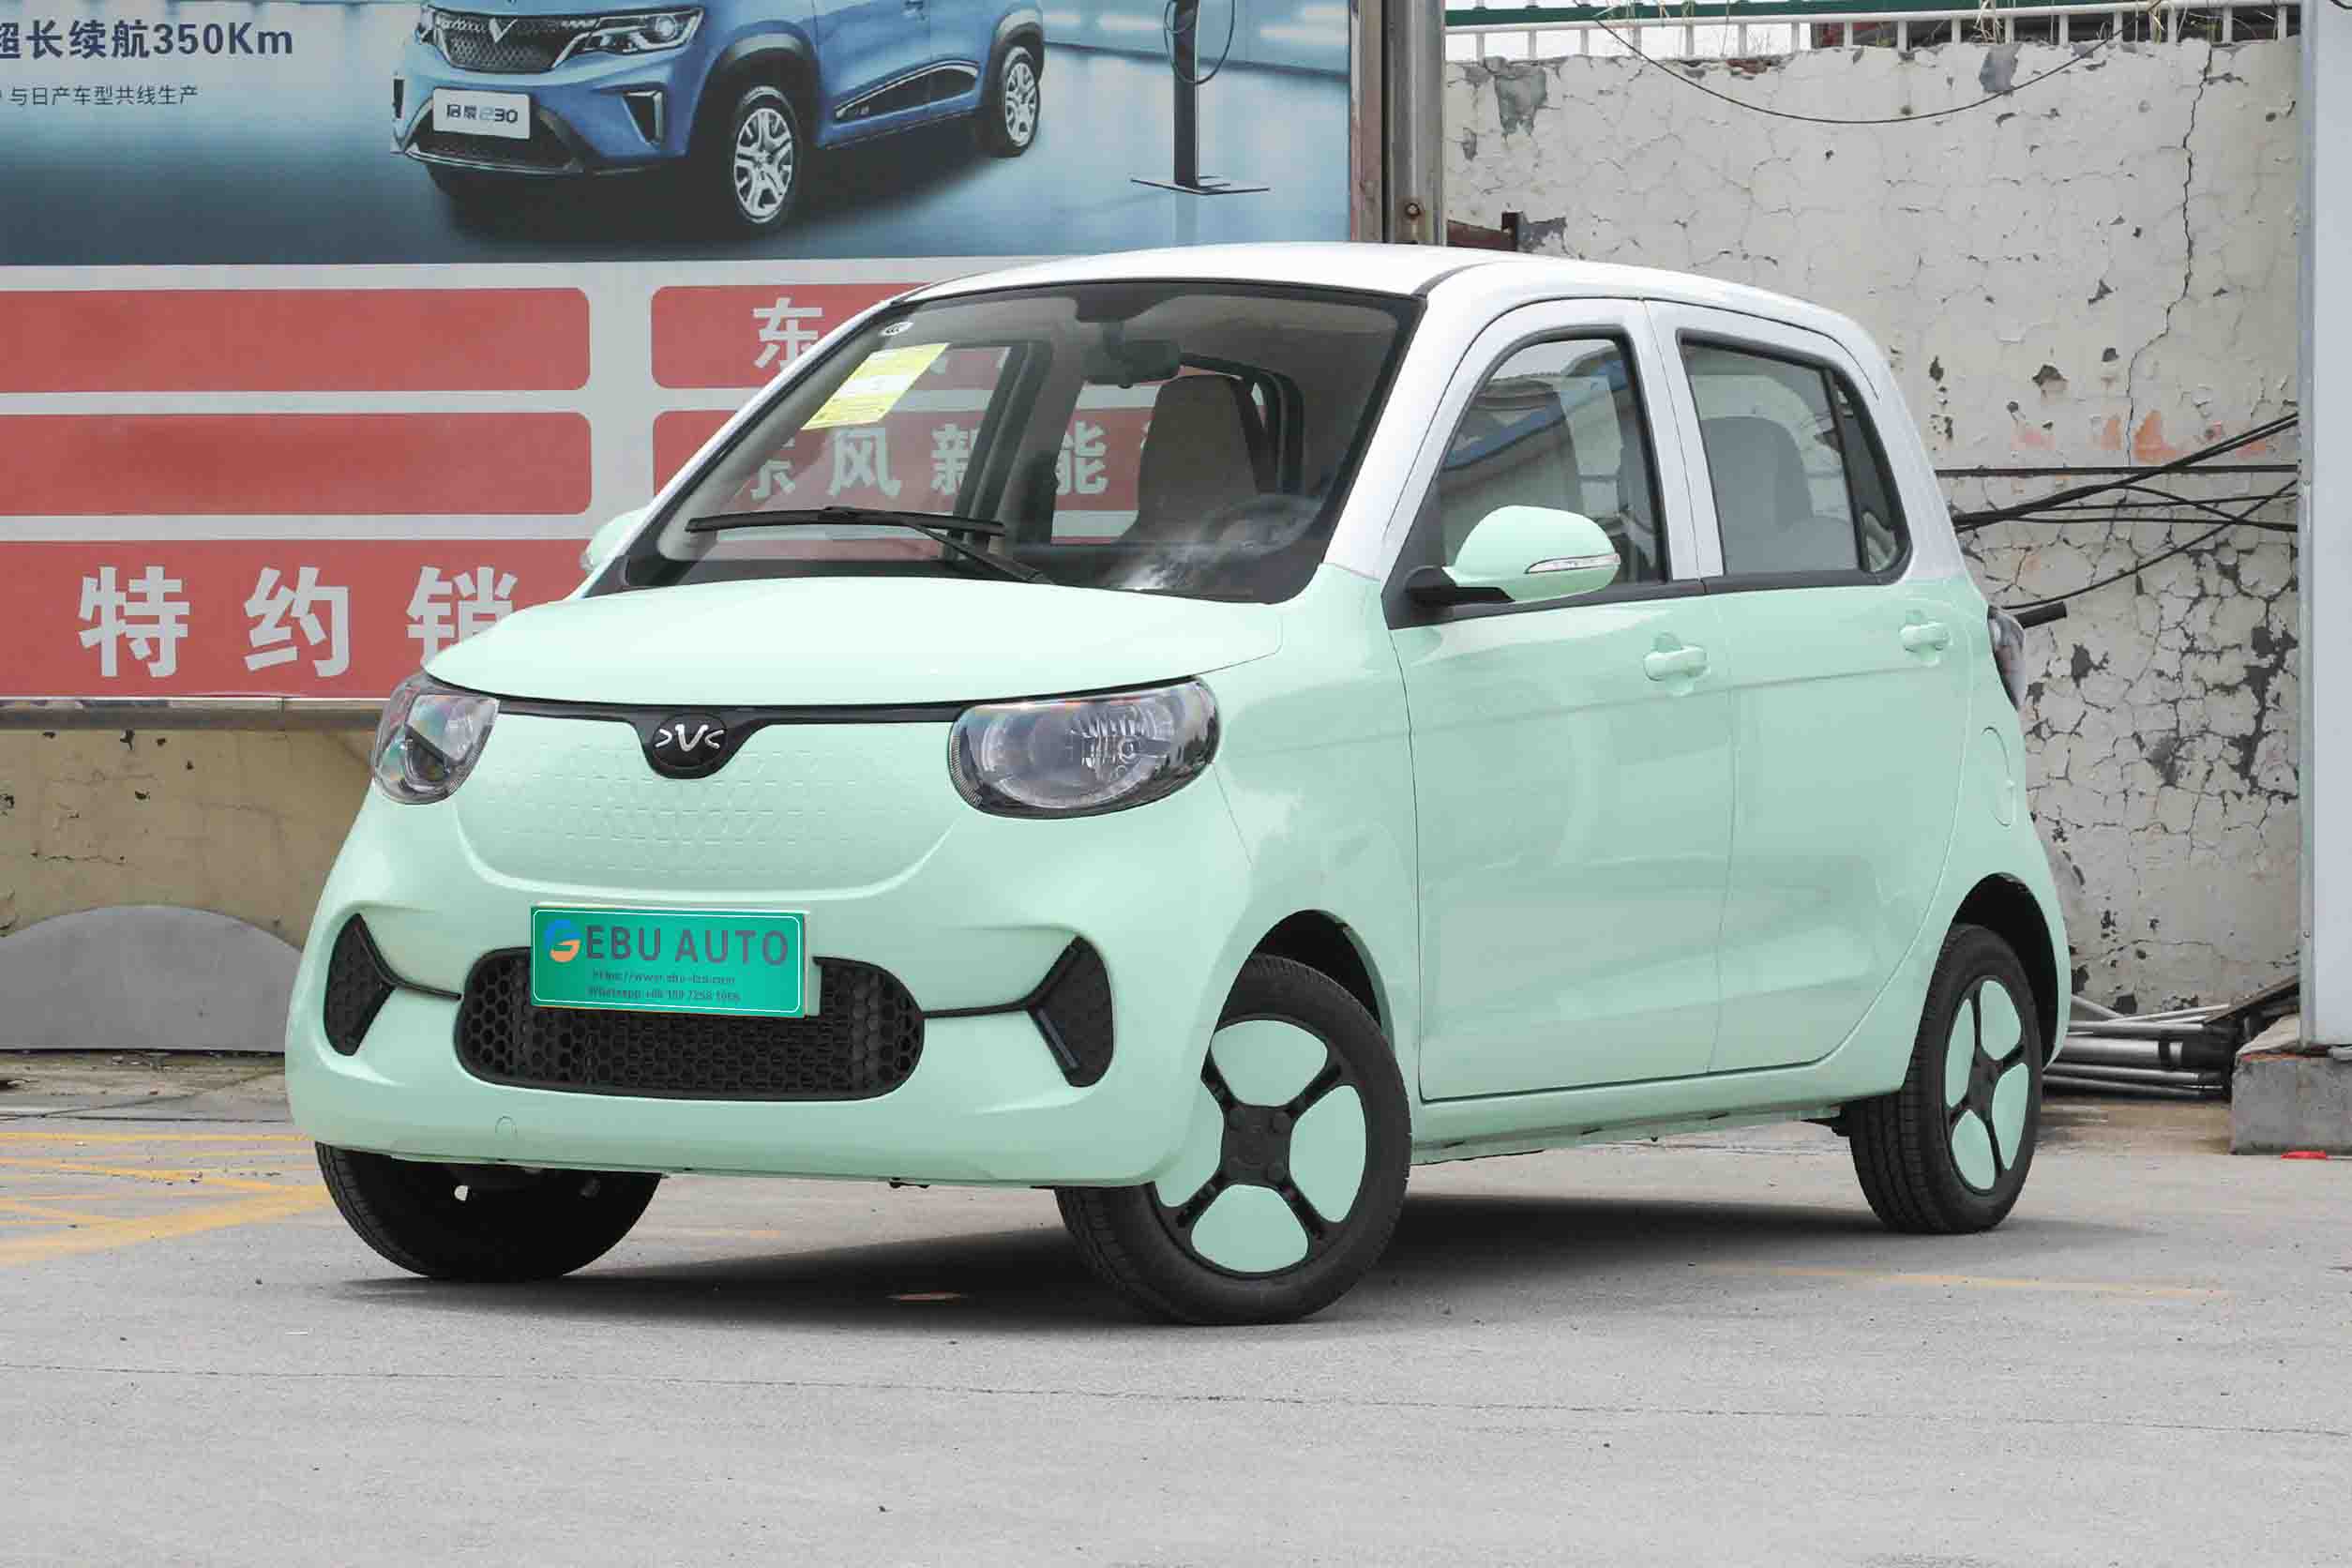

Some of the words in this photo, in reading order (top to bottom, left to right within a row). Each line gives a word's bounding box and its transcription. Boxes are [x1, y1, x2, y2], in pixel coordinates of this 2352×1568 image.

[10, 85, 199, 106] 与日产车型共线生产
[585, 925, 661, 962] EBU
[674, 928, 789, 966] AUTO
